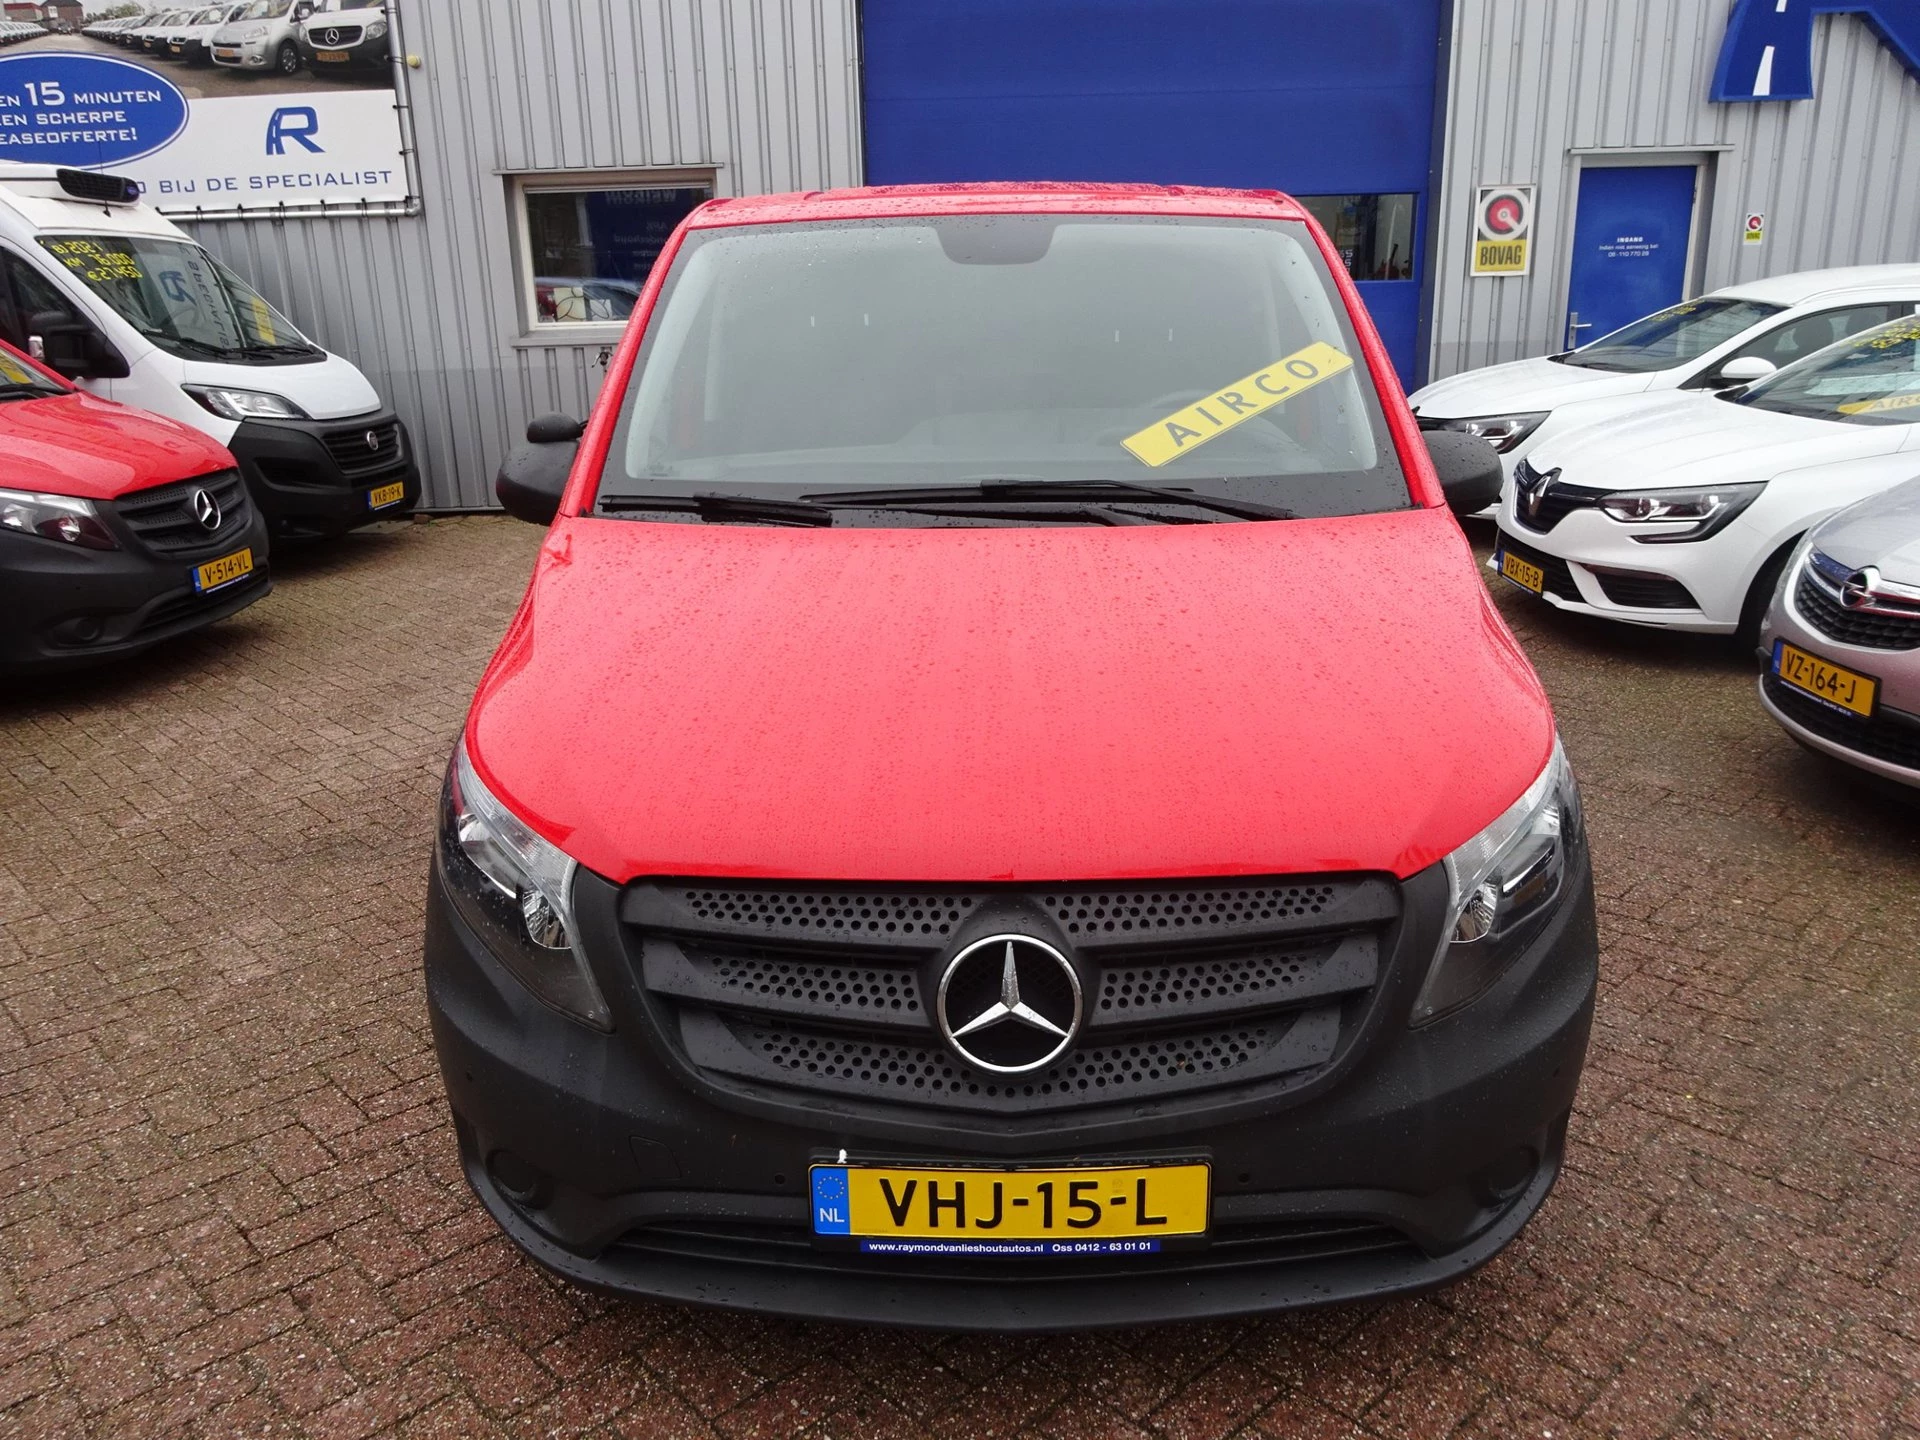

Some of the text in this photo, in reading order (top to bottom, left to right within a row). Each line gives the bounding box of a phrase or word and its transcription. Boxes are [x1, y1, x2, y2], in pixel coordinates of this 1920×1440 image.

[25, 82, 65, 106] 15
[74, 91, 161, 104] MINUTEN
[37, 111, 126, 125] SCHERPE
[160, 180, 196, 193] BIJ
[207, 177, 238, 191] DE
[249, 171, 392, 189] SPECIALIST
[1480, 245, 1522, 266] BOVAG
[1165, 359, 1319, 447] AIRCO
[204, 554, 249, 584] V-514-VL
[1505, 555, 1539, 588] VBX-15-B
[1786, 651, 1857, 704] VZ-164-J
[820, 1207, 845, 1223] NL
[879, 1177, 1168, 1229] VHJ-15-L
[869, 1243, 1044, 1253] www.raymondvanlieshoutautos.nl
[1052, 1243, 1073, 1252] Oss
[1075, 1243, 1100, 1252] 0412
[1109, 1242, 1122, 1251] 63
[1124, 1242, 1136, 1251] 01
[1138, 1241, 1151, 1250] 01
